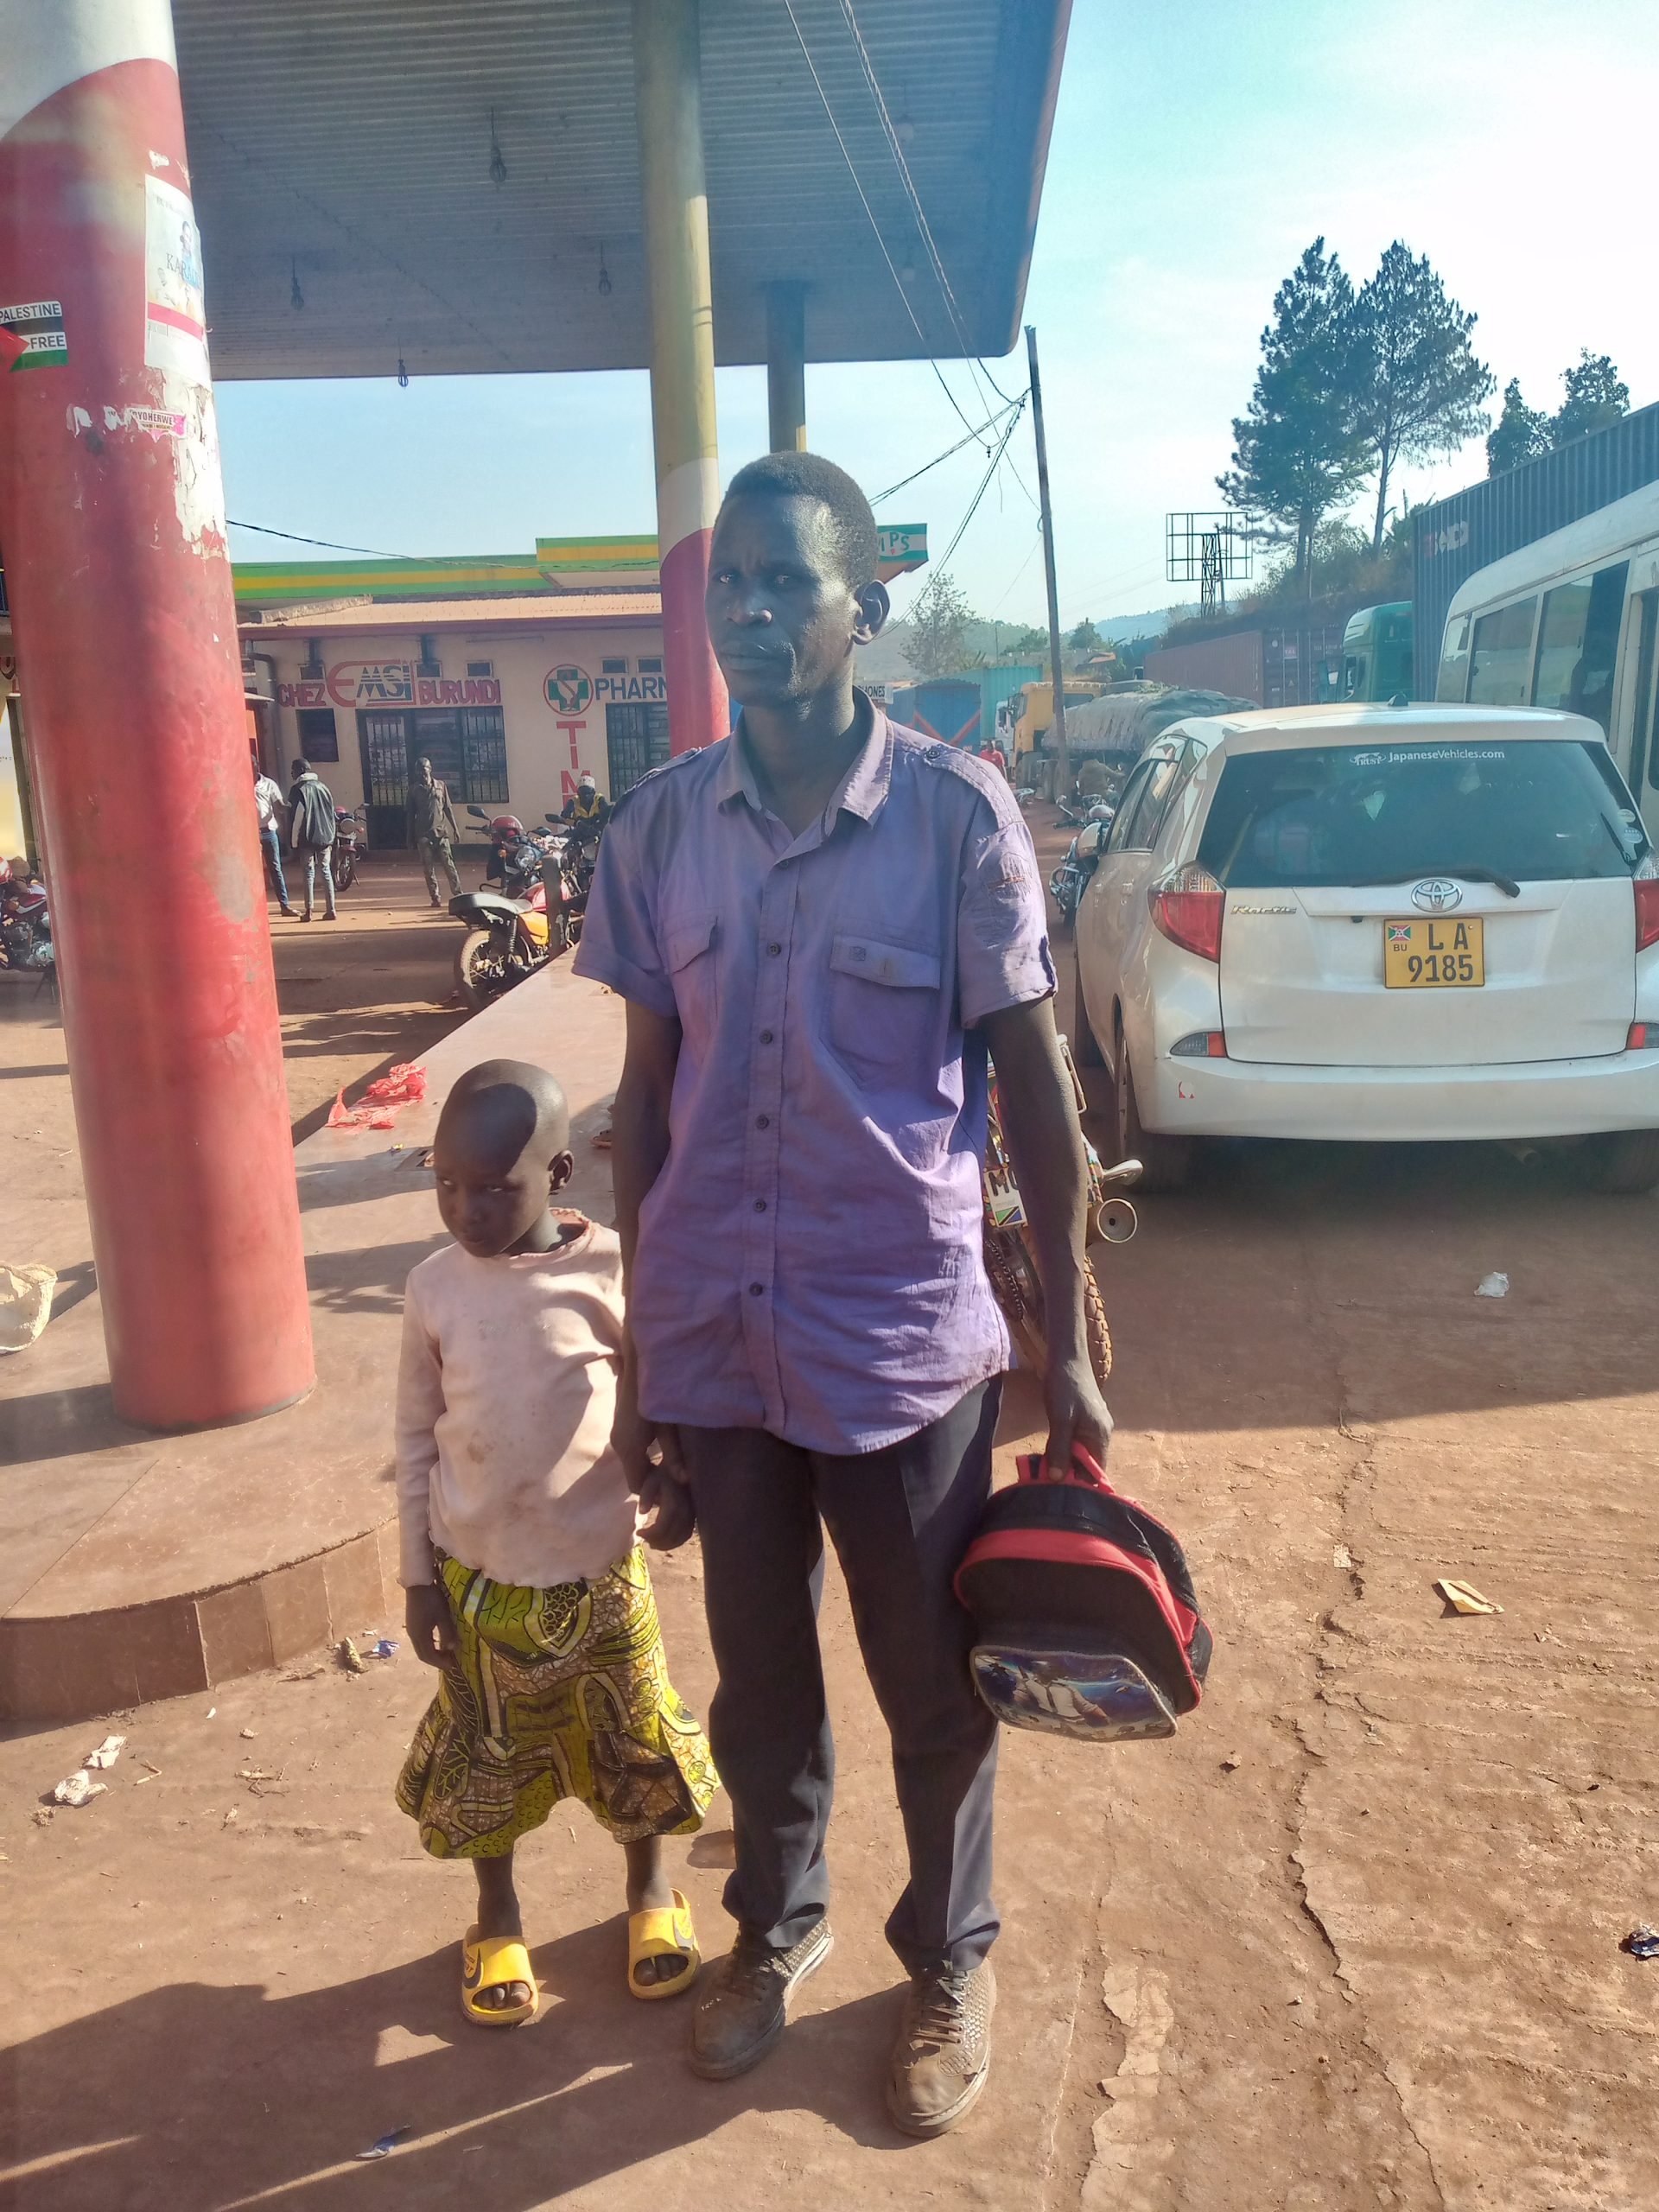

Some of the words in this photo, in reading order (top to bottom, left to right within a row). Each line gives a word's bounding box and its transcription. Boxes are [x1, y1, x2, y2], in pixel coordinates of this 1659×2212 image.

[0, 303, 60, 322] PALESTINE
[30, 335, 66, 349] FREE
[278, 683, 327, 707] CHEZ
[416, 678, 502, 706] BURUNDI
[1388, 749, 1505, 763] JapaneseVehicles.com
[1408, 955, 1473, 982] 9185
